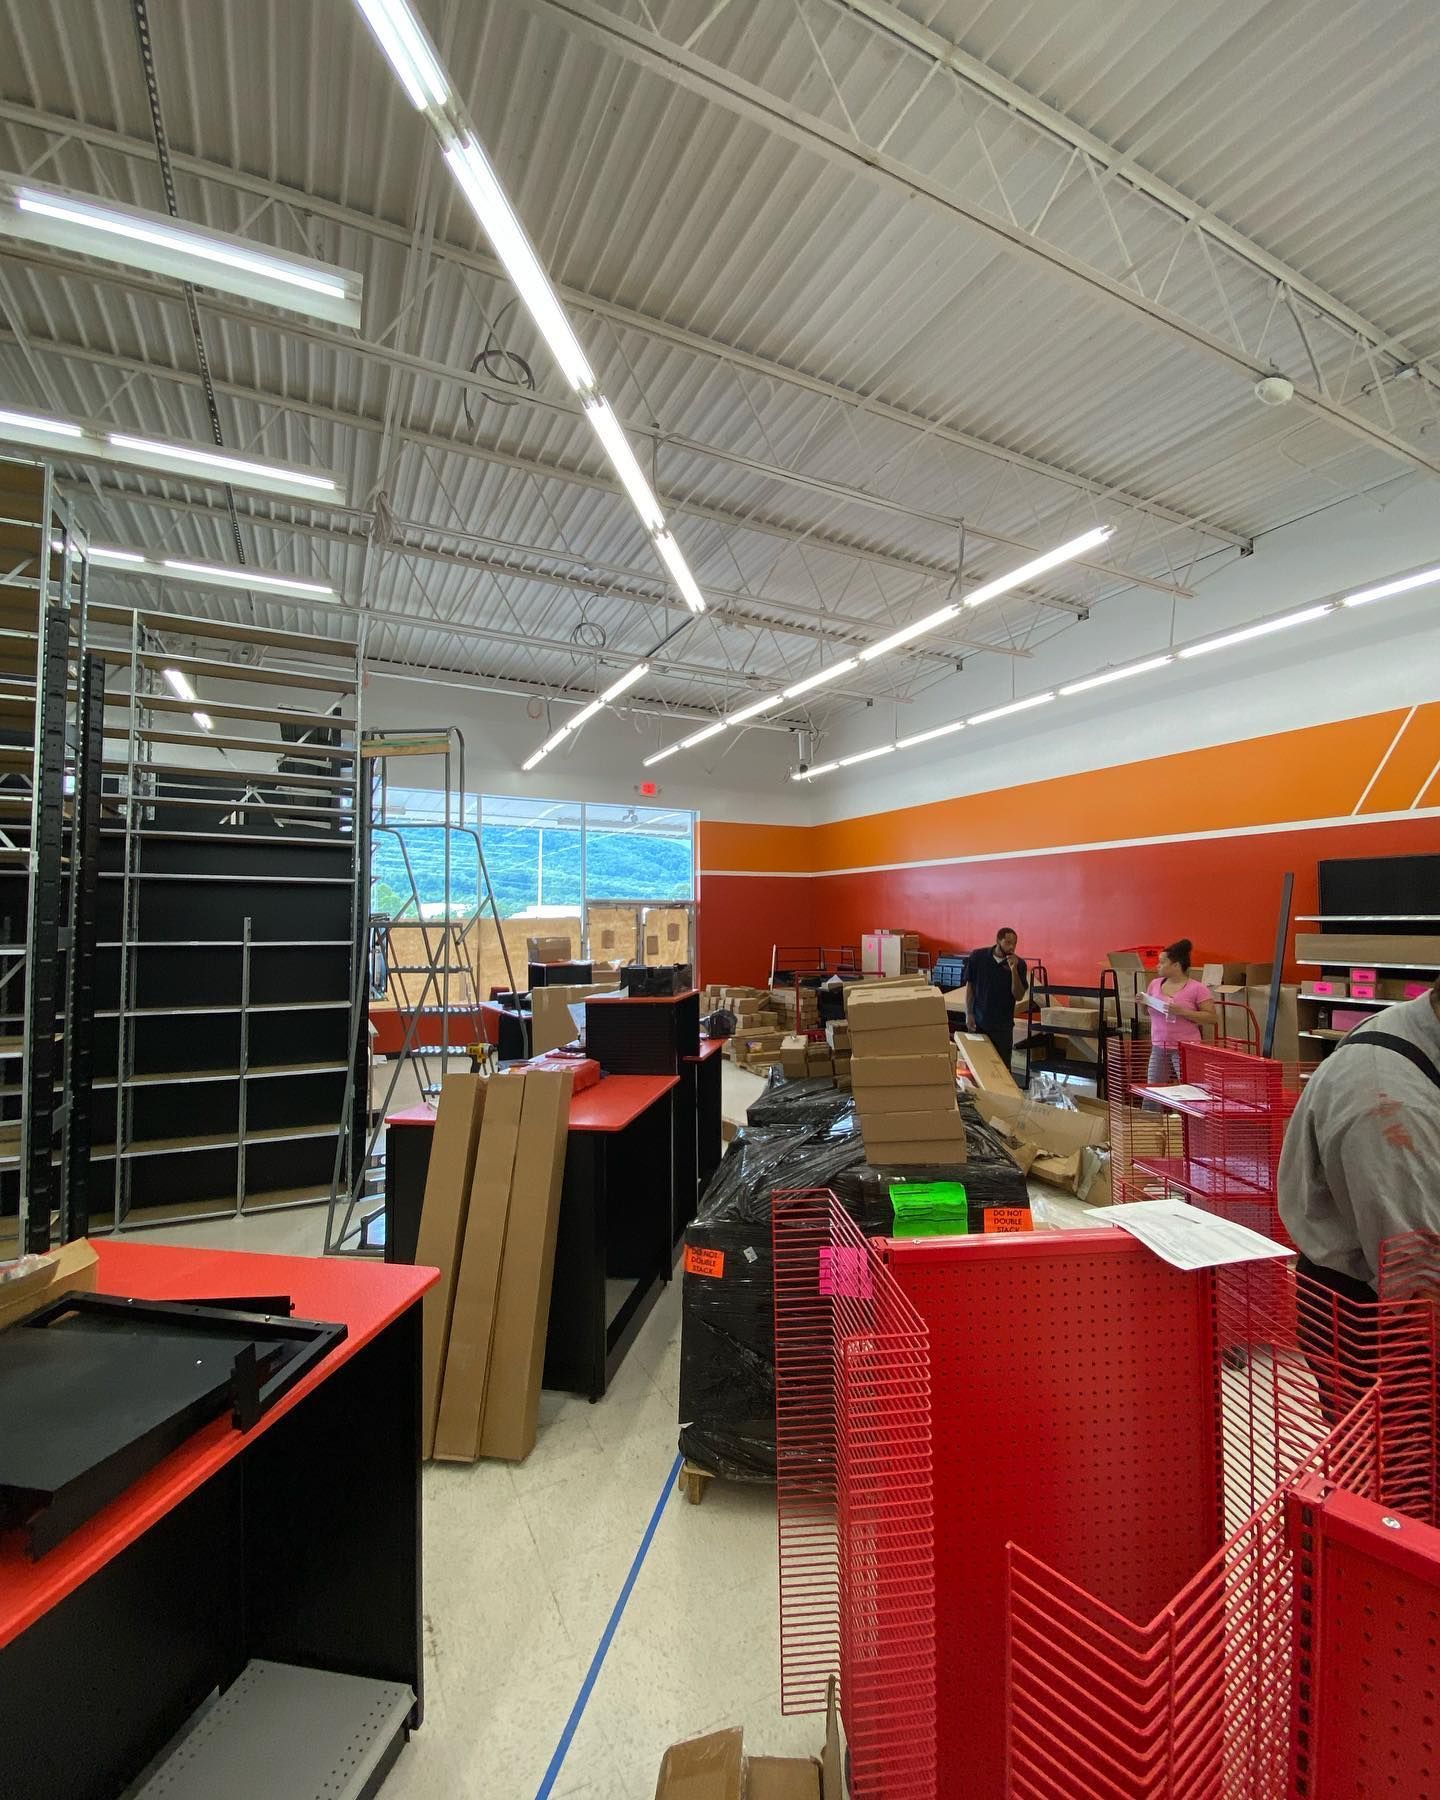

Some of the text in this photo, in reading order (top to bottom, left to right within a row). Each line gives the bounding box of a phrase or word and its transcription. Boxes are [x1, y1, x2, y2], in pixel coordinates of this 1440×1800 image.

[1007, 1209, 1023, 1217] NOT
[691, 1248, 718, 1258] DO NOT
[691, 1256, 716, 1267] DOUBLE
[692, 1264, 714, 1274] STACK
